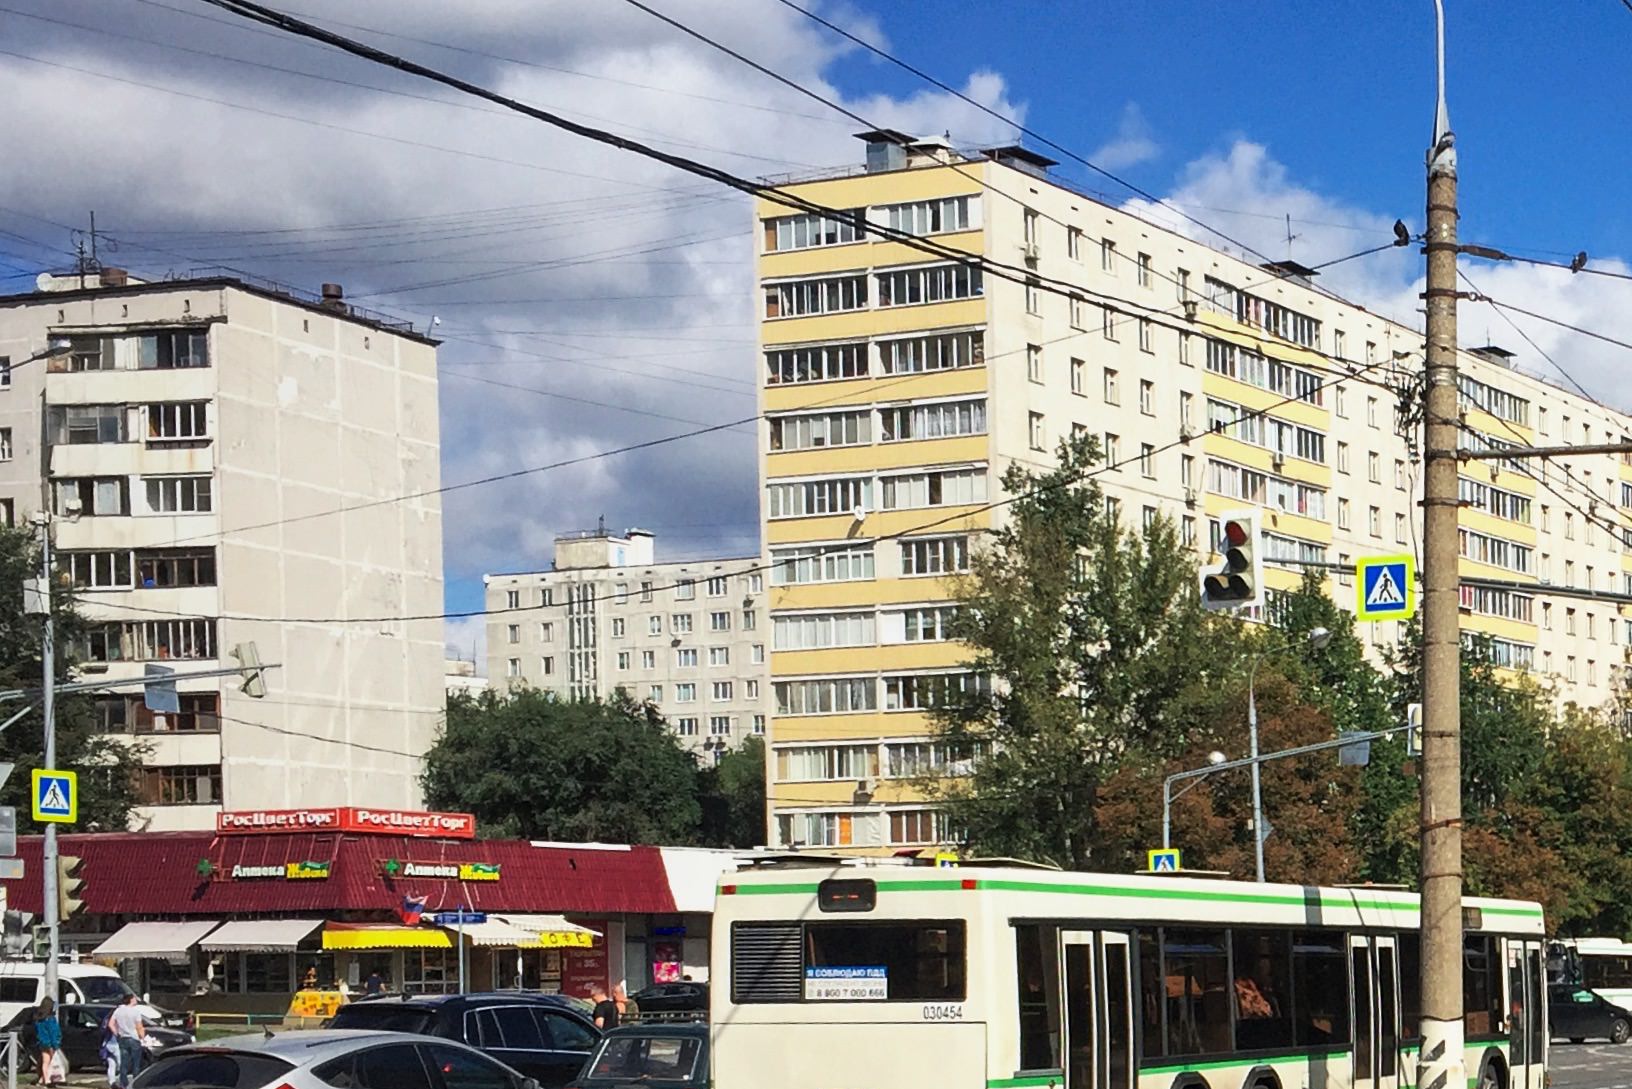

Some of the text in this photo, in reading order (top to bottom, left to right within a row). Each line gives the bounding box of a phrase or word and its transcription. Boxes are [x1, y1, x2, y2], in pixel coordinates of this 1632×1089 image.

[221, 810, 336, 827] РосЦветТорг
[356, 811, 469, 830] РосЦветТорг
[231, 864, 285, 877] Аптека
[403, 863, 458, 876] Аптека
[923, 1005, 963, 1019] 030454
